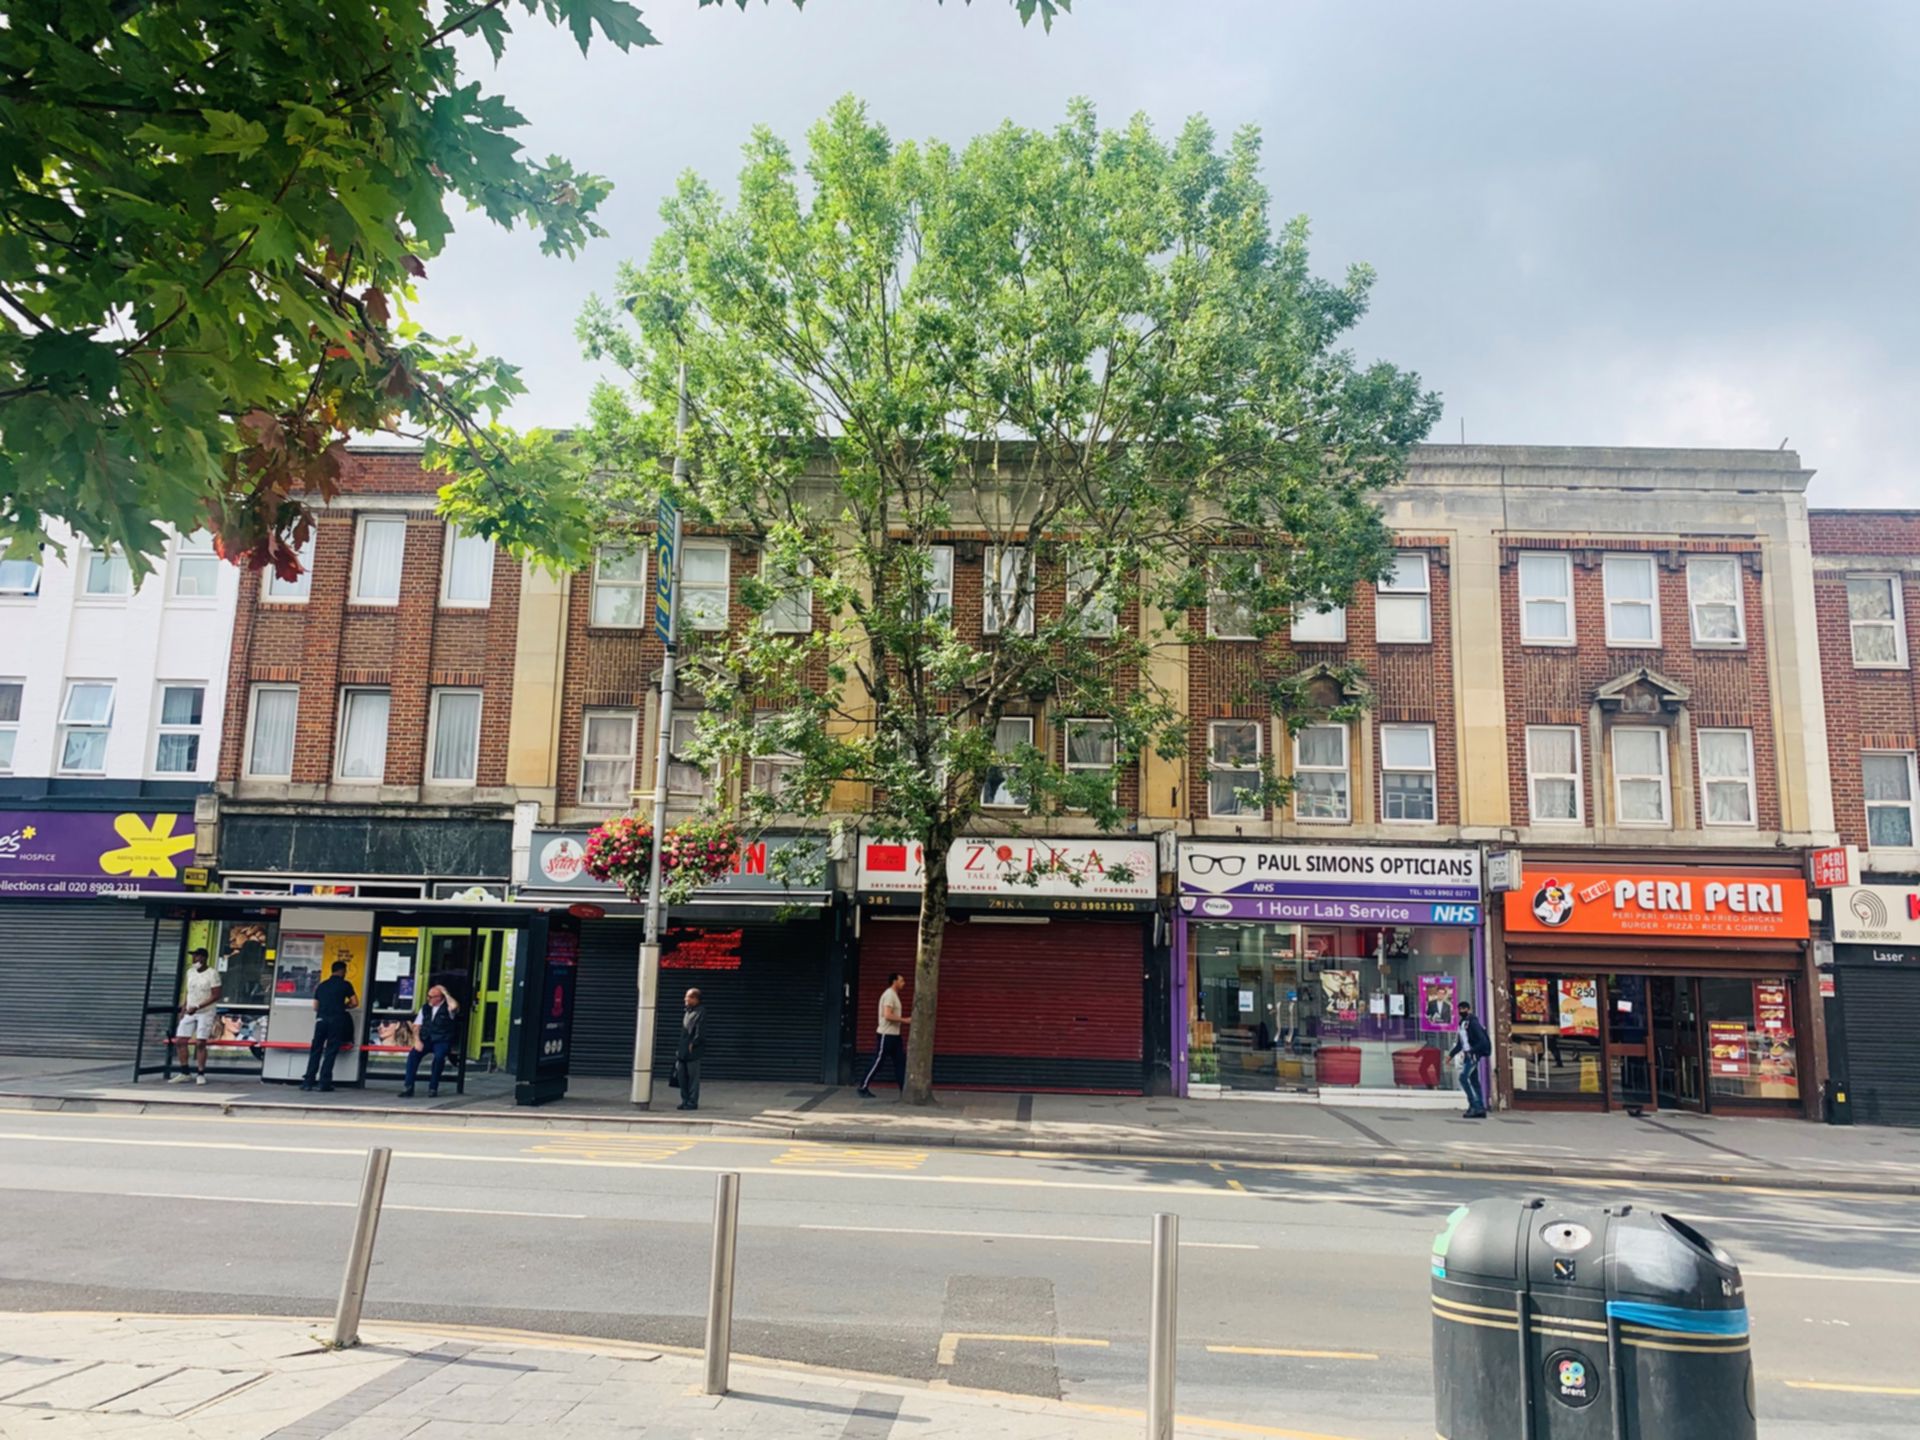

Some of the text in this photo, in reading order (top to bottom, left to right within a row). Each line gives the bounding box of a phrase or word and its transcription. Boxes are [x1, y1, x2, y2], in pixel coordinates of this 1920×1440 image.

[19, 853, 56, 862] HOSPICE
[1822, 850, 1845, 869] PERI
[1258, 853, 1473, 876] PAUL SIMONS OPTICIANS
[967, 872, 991, 880] TAKE
[1823, 866, 1846, 884] PERI
[0, 880, 141, 893] llections call 020 8909 2311
[1252, 883, 1275, 893] NHS
[1581, 881, 1609, 902] NEW
[867, 896, 891, 905] 381
[1614, 879, 1783, 913] PERI PERI
[1053, 901, 1135, 911] 020 8903 1933
[1256, 902, 1410, 919] 1 Hour Lab Service
[1433, 905, 1475, 922] NHS
[1612, 911, 1633, 919] PERI
[1662, 913, 1701, 922] GRILLED
[1712, 914, 1739, 923] FRIED
[1742, 915, 1784, 923] CHICKEN
[1621, 921, 1659, 929] BURGER
[1667, 922, 1694, 930] PIZZA
[1702, 923, 1722, 931] RICE
[1735, 924, 1776, 932] CURRIES
[1873, 950, 1904, 962] Laser
[1560, 1385, 1587, 1397] Brent
